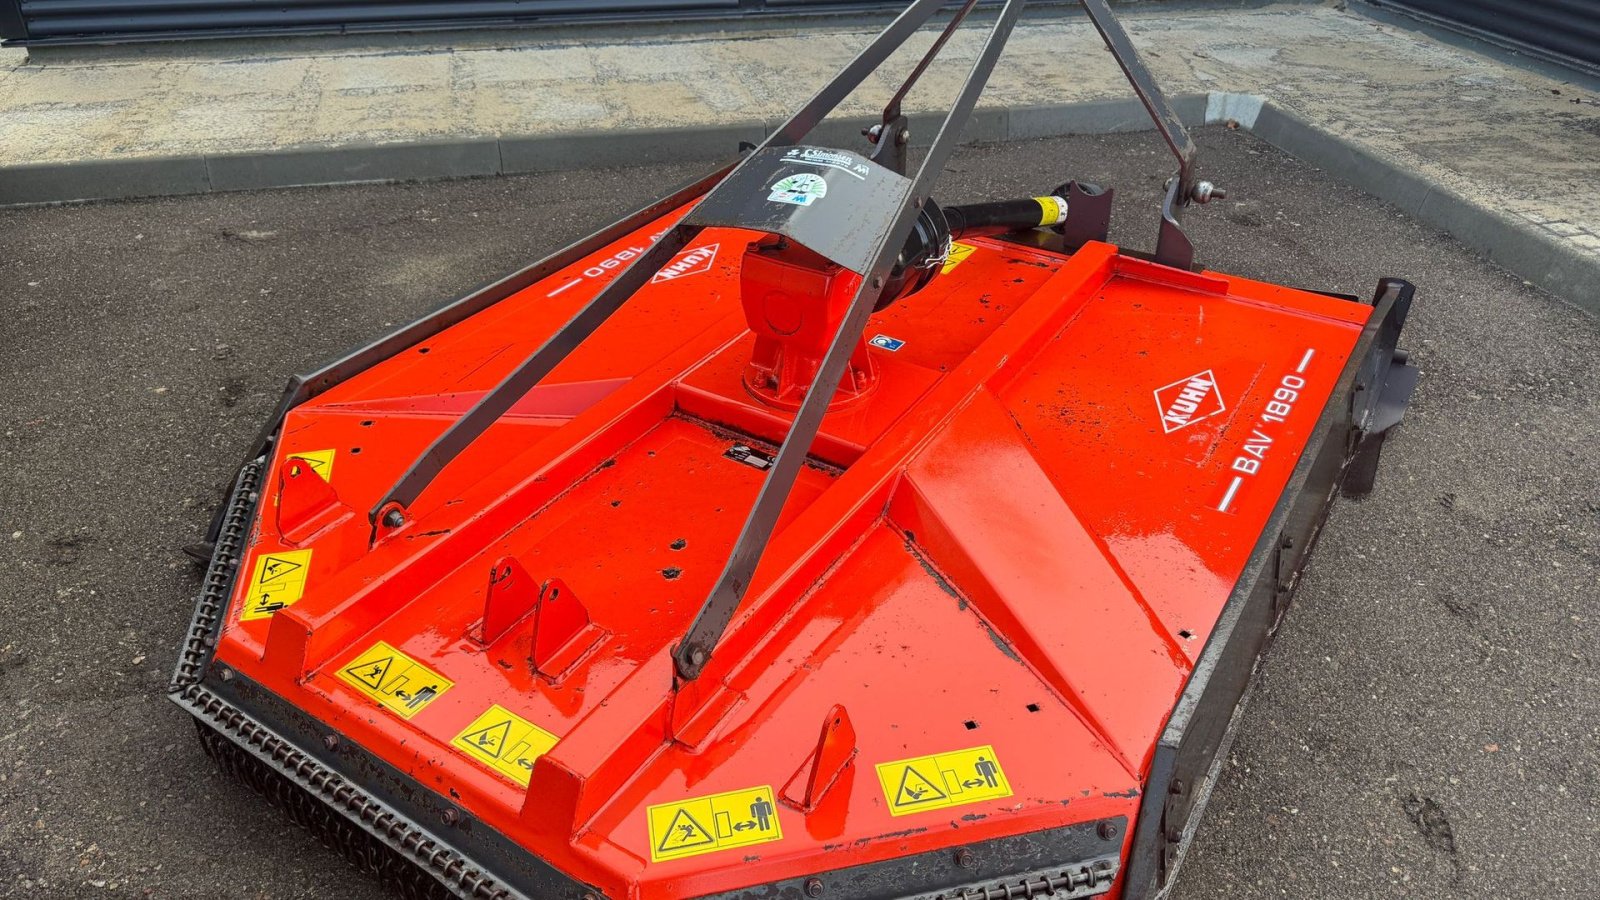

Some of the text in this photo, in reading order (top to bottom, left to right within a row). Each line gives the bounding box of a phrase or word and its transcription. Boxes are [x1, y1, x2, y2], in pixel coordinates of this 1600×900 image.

[583, 246, 645, 278] 1890
[659, 248, 713, 279] KUHN
[1163, 376, 1215, 426] KUHN
[1231, 374, 1306, 476] BAV 1890
